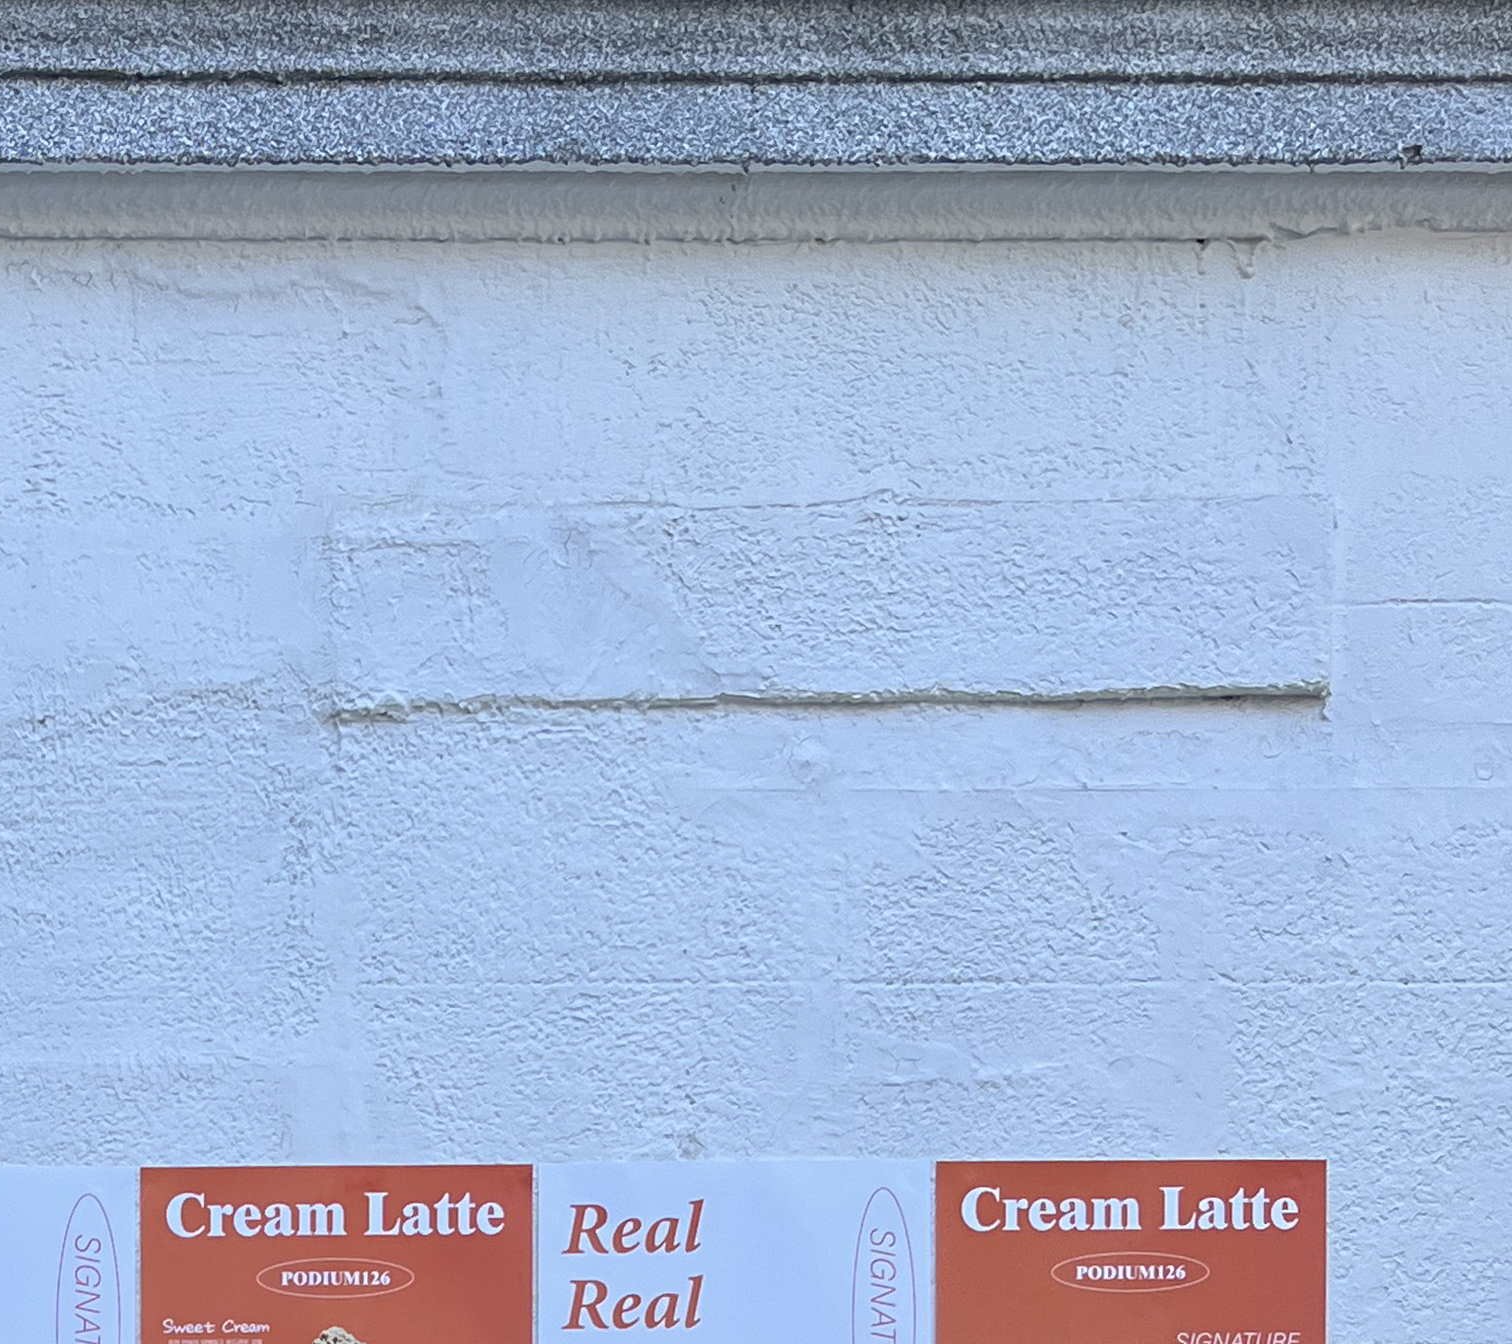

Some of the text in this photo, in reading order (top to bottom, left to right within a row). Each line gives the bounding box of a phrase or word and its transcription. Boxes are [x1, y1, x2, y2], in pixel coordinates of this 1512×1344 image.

[166, 1192, 504, 1237] Cream Latte
[562, 1199, 703, 1254] Real
[962, 1187, 1298, 1231] Cream Latte
[280, 1270, 390, 1286] PODIUM126
[1075, 1264, 1187, 1281] PODIUM126
[562, 1275, 703, 1329] Real
[163, 1319, 269, 1333] Sweet Cream
